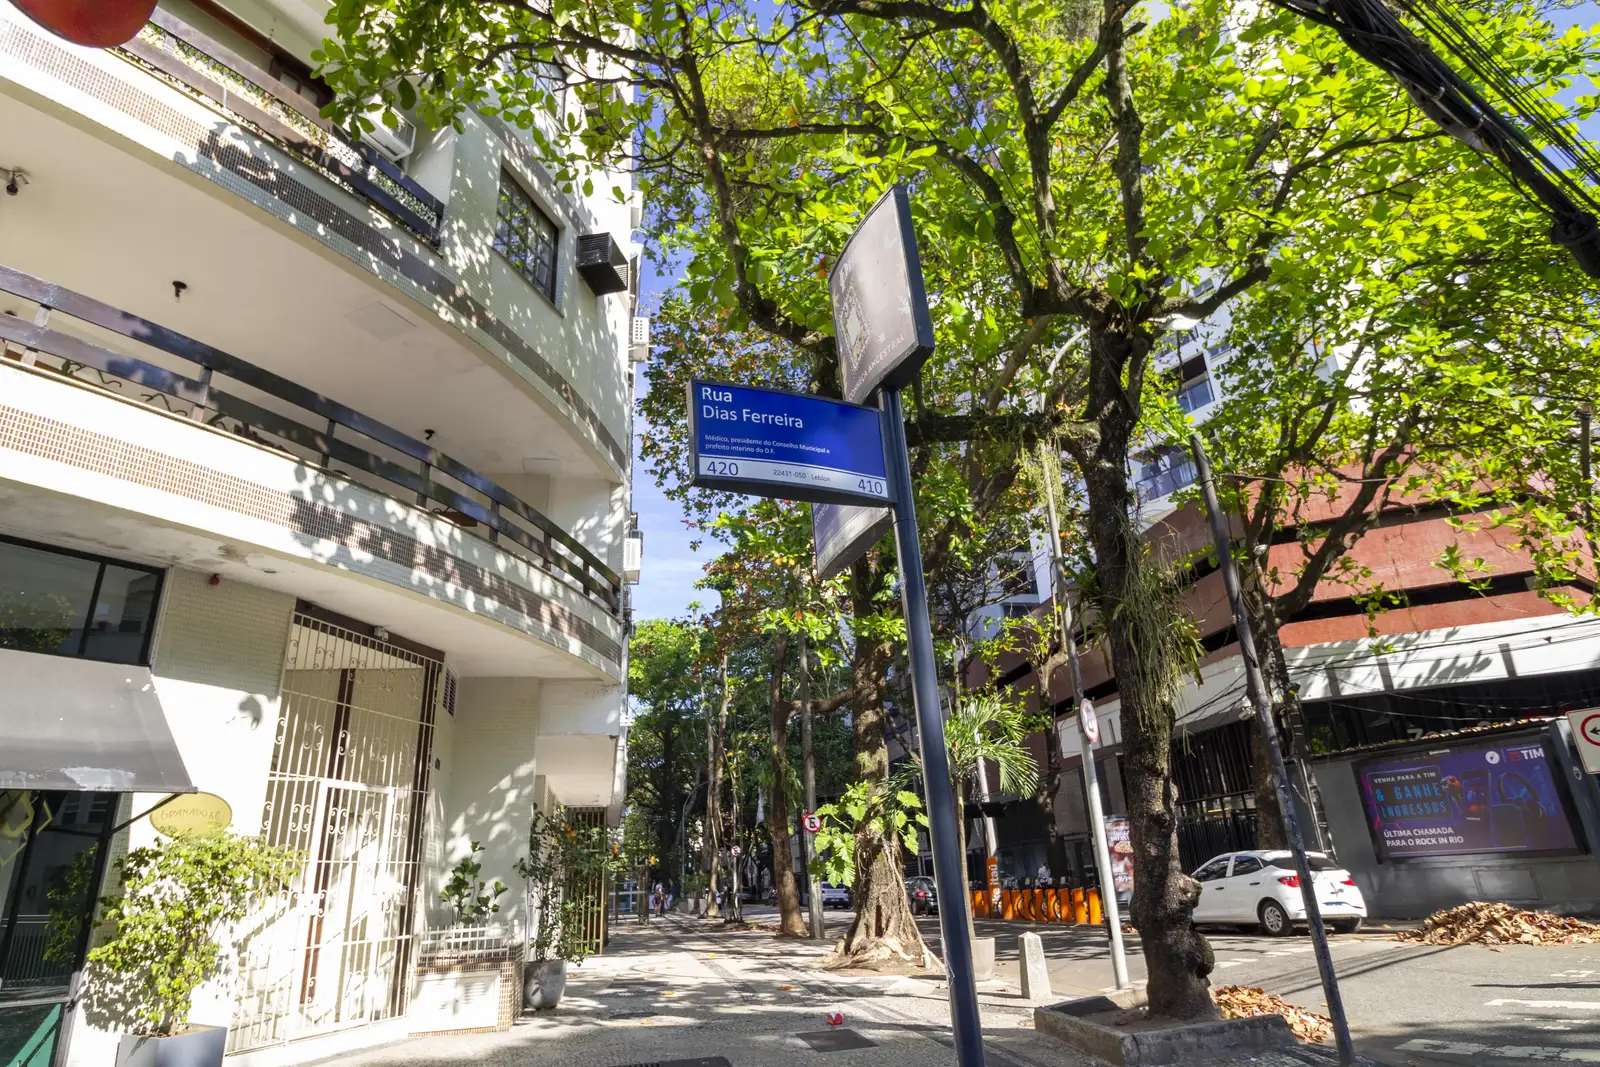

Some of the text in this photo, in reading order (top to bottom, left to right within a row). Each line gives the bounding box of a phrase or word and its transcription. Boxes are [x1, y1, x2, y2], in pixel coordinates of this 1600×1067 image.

[702, 387, 733, 403] Rua
[703, 405, 803, 429] Dias Ferreira
[705, 434, 730, 443] Médico,
[730, 438, 762, 446] presidente
[772, 440, 799, 449] Conselho
[800, 444, 826, 454] Municipal
[705, 443, 730, 451] prefeito
[731, 445, 755, 453] interino
[764, 447, 776, 455] D.F.
[707, 461, 739, 476] 420
[773, 469, 832, 483] 22431-050 Leblon
[858, 479, 883, 495] 410
[1520, 747, 1545, 760] TIM
[1393, 782, 1441, 800] GANHE
[1381, 800, 1447, 818] INGRESSOS
[1383, 826, 1454, 838] ÚLTIMA CHAMADA
[1386, 835, 1464, 847] PARA O ROCK IN RIO
